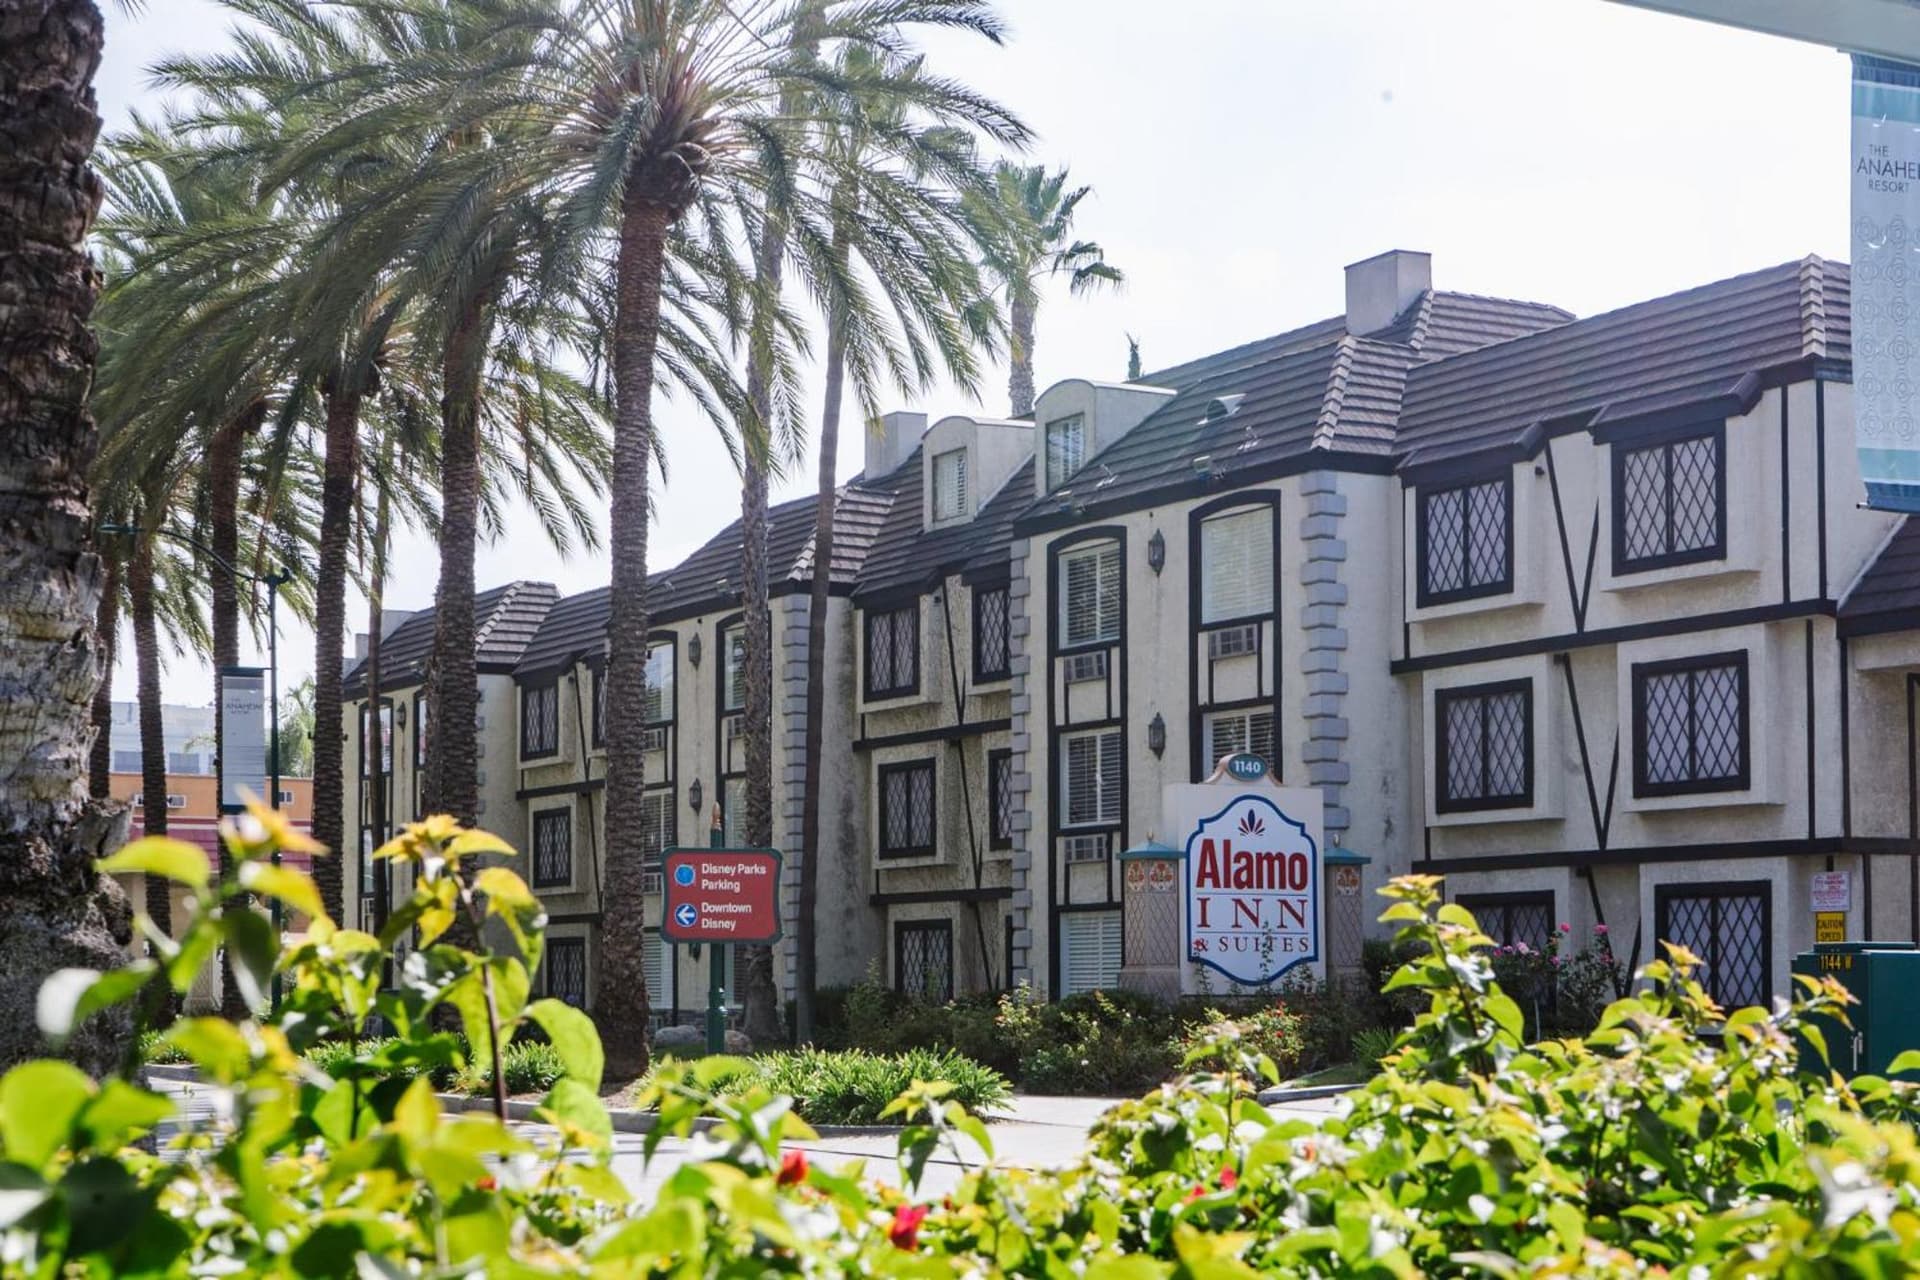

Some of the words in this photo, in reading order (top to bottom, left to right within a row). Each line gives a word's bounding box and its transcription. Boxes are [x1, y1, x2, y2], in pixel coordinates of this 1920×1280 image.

[1868, 144, 1889, 157] THE
[1868, 179, 1910, 193] RESORT
[1234, 760, 1261, 774] 1140
[702, 863, 736, 876] Disney
[738, 863, 766, 875] Parks
[1196, 838, 1309, 891] Alamo
[702, 879, 741, 893] Parking
[702, 902, 752, 913] Downtown
[1196, 897, 1309, 929] INN
[702, 918, 736, 931] Disney
[1818, 919, 1843, 930] CAUTION
[1820, 931, 1841, 940] SPEED
[1821, 955, 1841, 970] 1144
